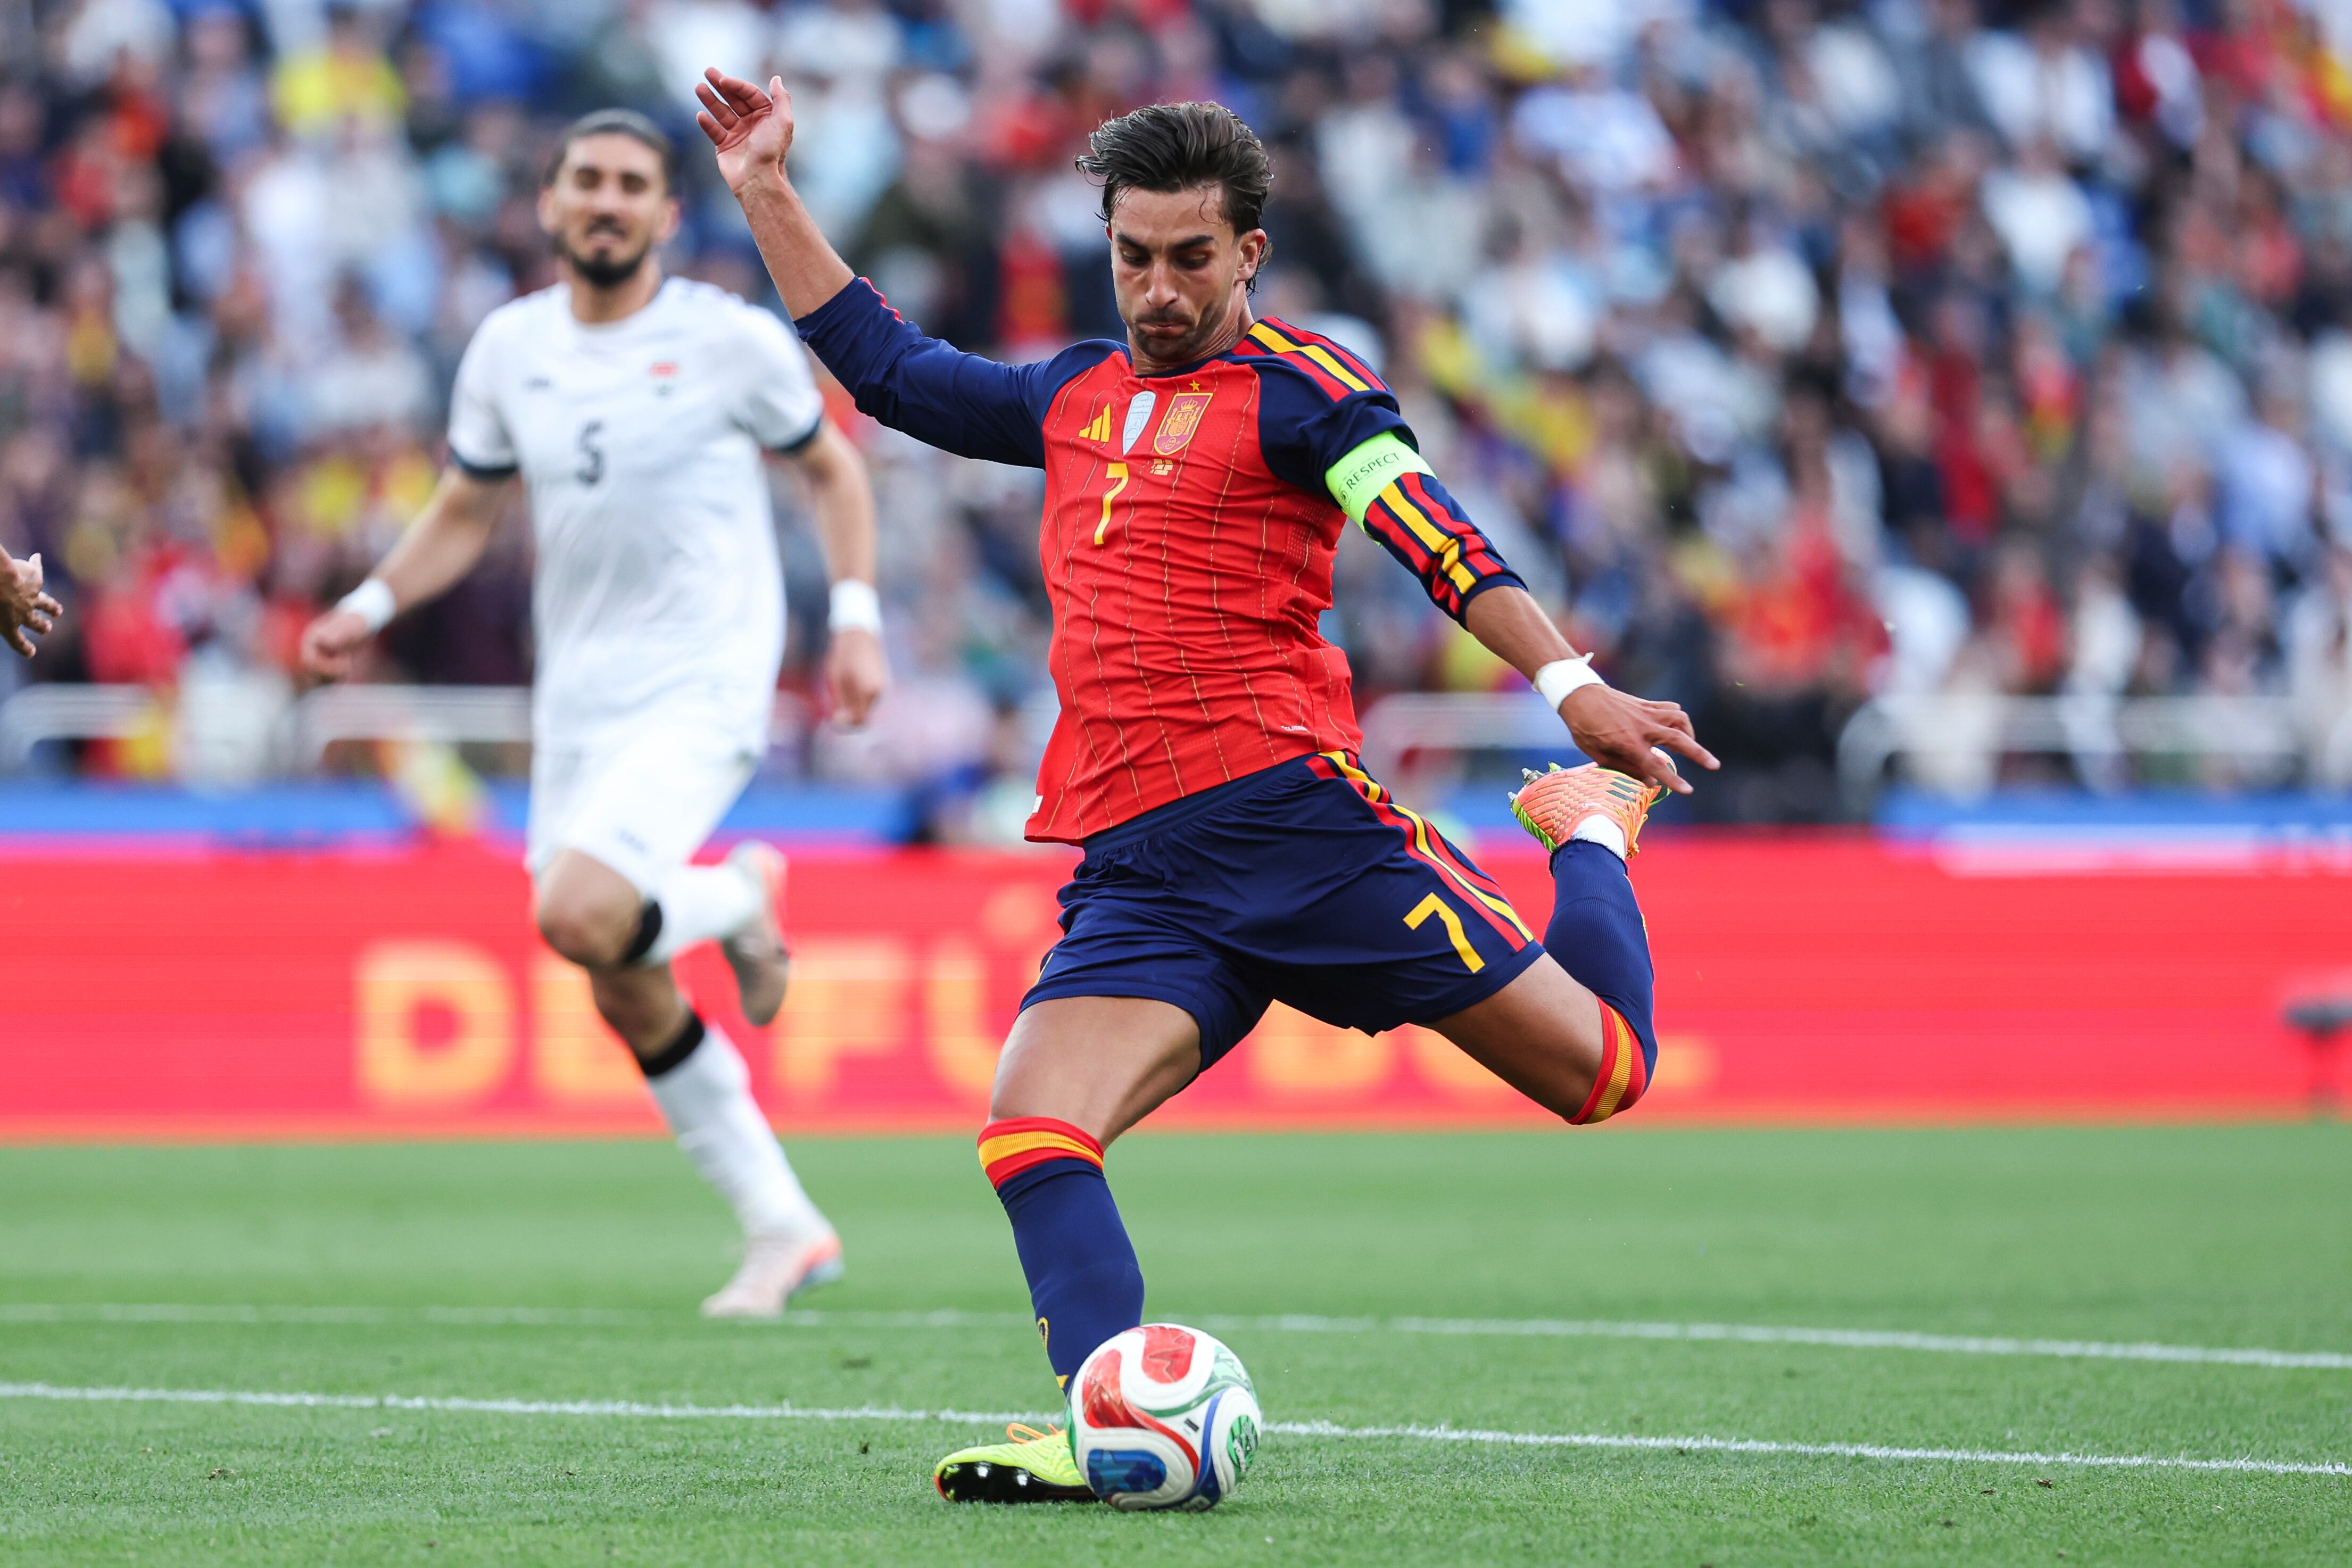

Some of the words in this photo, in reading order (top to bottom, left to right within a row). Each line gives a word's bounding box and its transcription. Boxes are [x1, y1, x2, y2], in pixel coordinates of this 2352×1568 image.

[576, 420, 605, 486] 5
[1346, 452, 1400, 490] RESPECT
[1093, 463, 1129, 545] 7
[1403, 892, 1486, 973] 7
